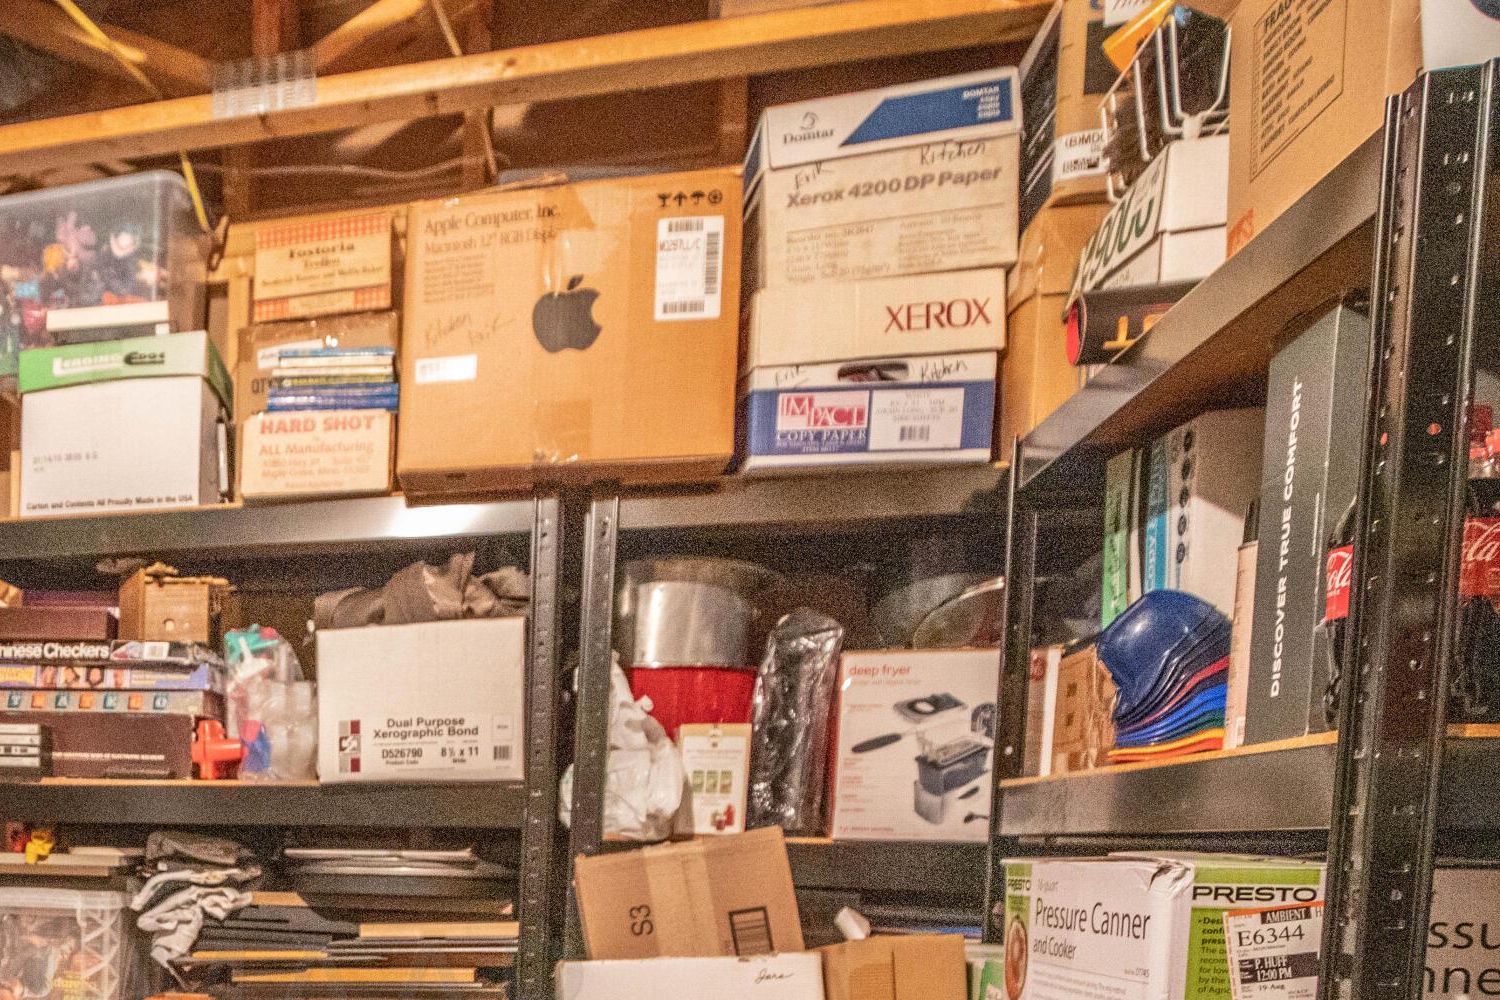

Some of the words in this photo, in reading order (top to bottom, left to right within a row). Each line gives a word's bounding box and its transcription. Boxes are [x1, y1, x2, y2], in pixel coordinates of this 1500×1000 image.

[783, 128, 835, 145] Domtar
[787, 191, 845, 208] Xerox
[849, 179, 900, 199] 4200
[903, 173, 935, 191] DP
[938, 166, 1002, 188] Paper
[424, 215, 461, 237] Apple
[536, 203, 561, 219] Inc.
[884, 297, 993, 333] XEROX
[260, 417, 317, 435] HARD
[323, 415, 374, 432] SHOT
[822, 429, 867, 441] PAPER
[1284, 375, 1303, 502] COMFORT
[260, 443, 281, 456] ALL
[285, 441, 374, 454] Manufacturing
[27, 502, 49, 510] Carton
[51, 501, 64, 509] and
[65, 499, 95, 509] Contents
[108, 498, 133, 508] Proudly
[179, 495, 193, 503] USA
[1279, 505, 1292, 573] TRUE
[1270, 574, 1288, 698] DISCOVER
[44, 642, 110, 659] Checkers
[849, 665, 880, 678] deep
[882, 664, 912, 676] fryer
[387, 718, 413, 729] Dual
[416, 716, 466, 729] Purpose
[373, 727, 444, 740] Xerographic
[448, 726, 479, 737] Bond
[468, 746, 479, 756] 11
[1192, 886, 1318, 903] PRESTO
[629, 903, 655, 937] S3
[1035, 897, 1088, 933] Pressure
[1091, 902, 1151, 940] Canner
[1266, 907, 1307, 924] AMBIENT
[1238, 924, 1306, 948] E6344
[1033, 936, 1047, 955] and
[1049, 936, 1077, 960] Cooker
[1202, 946, 1217, 954] The
[1265, 956, 1288, 968] HUFF
[1257, 970, 1278, 981] 12:00
[1280, 967, 1293, 978] PM
